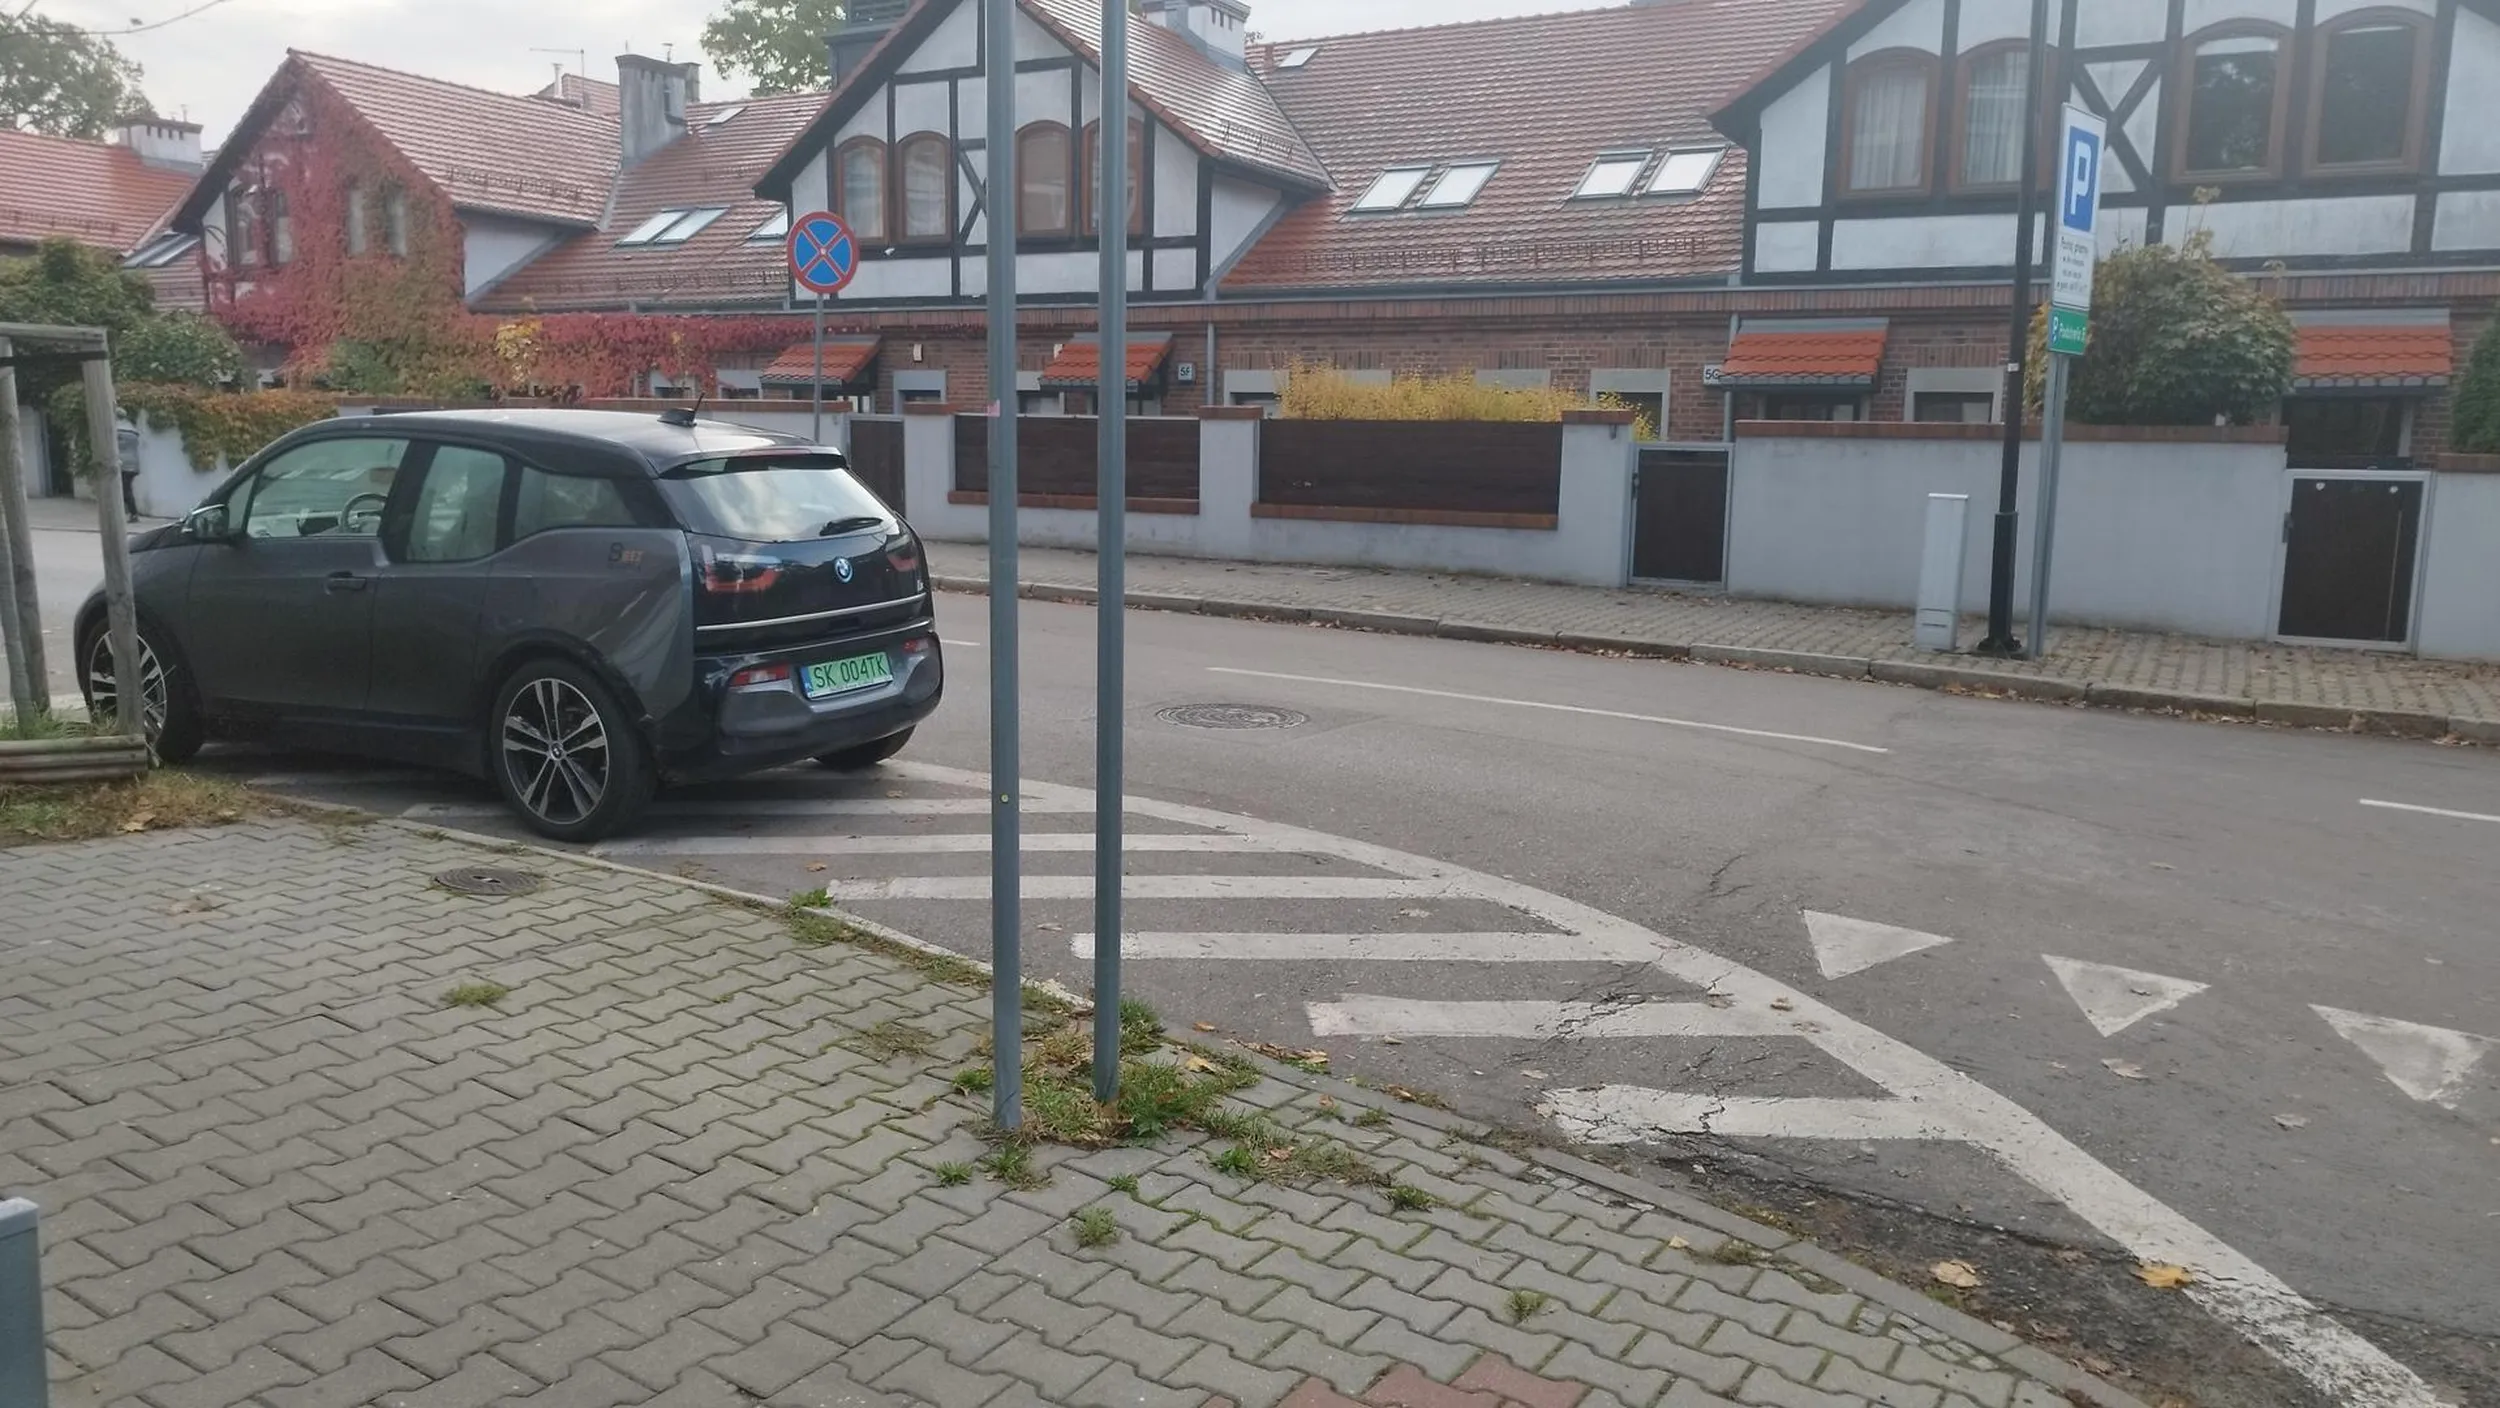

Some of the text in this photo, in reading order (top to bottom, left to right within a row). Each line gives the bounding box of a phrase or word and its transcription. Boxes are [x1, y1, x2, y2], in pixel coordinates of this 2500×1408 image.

[2070, 140, 2092, 215] P
[813, 655, 888, 688] SK 004TK
